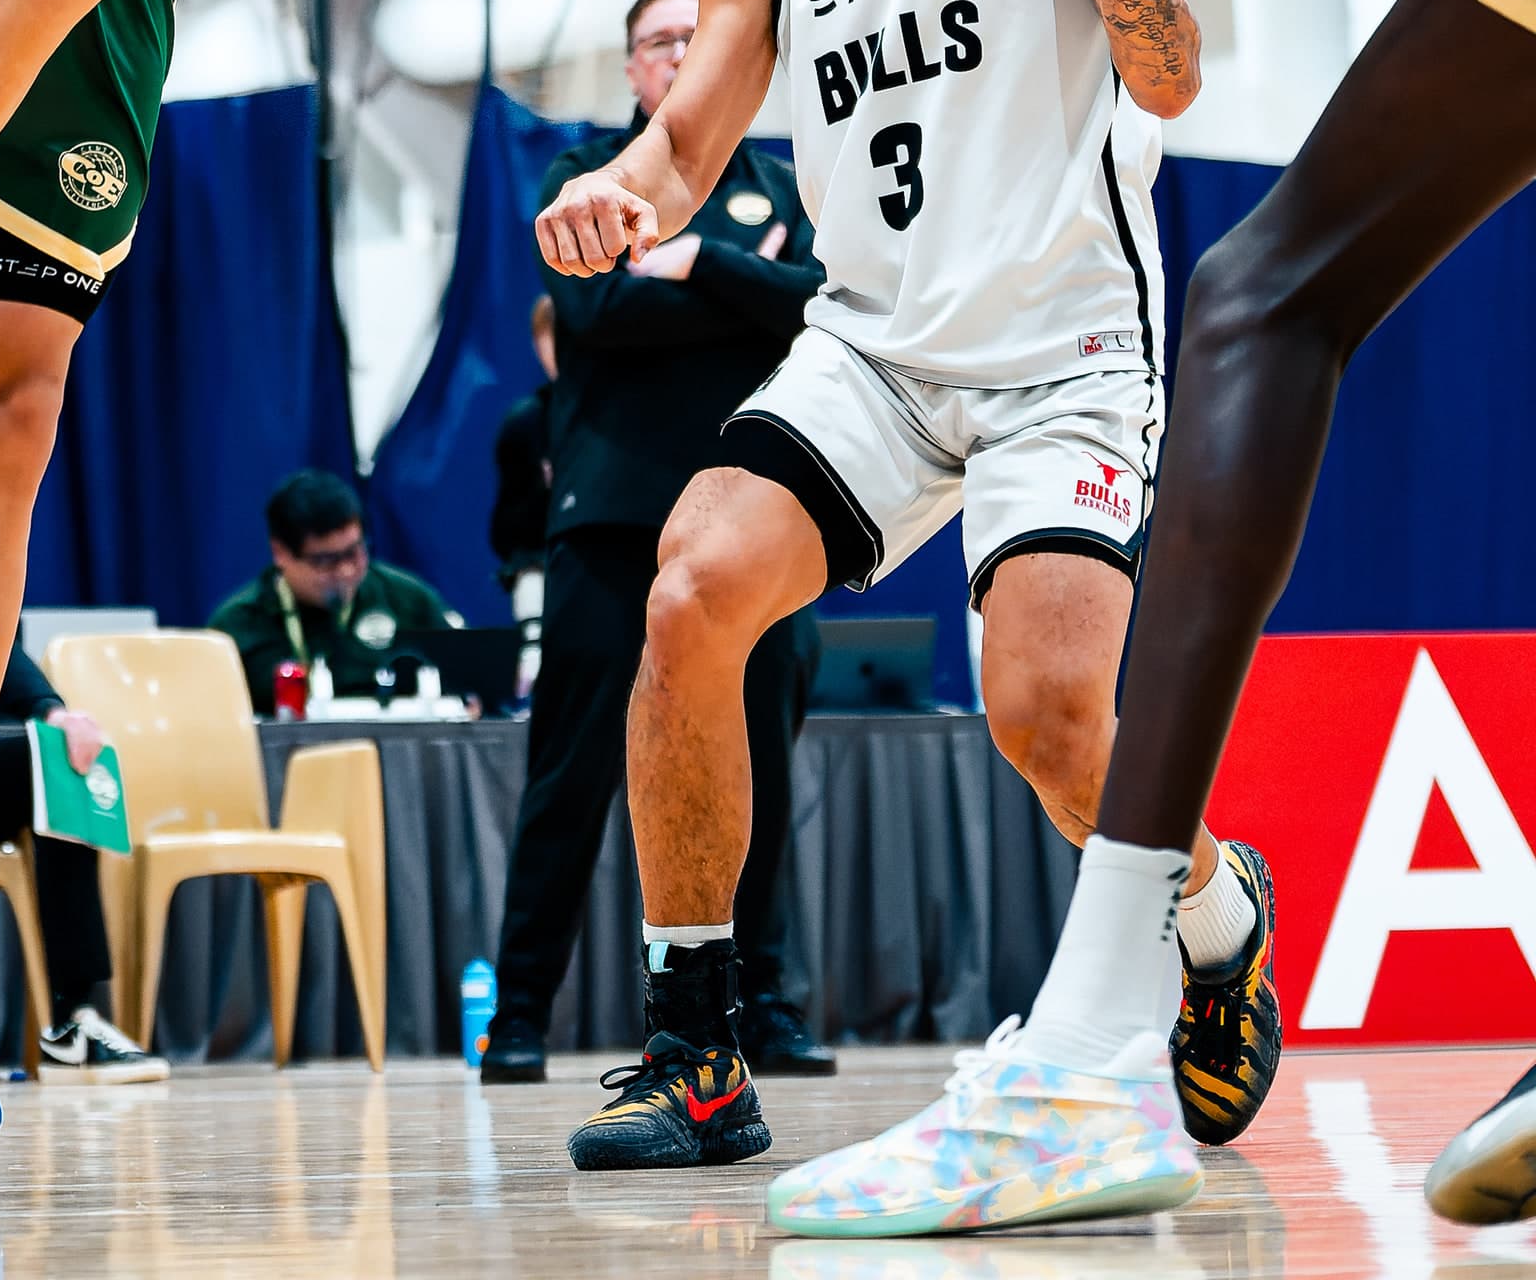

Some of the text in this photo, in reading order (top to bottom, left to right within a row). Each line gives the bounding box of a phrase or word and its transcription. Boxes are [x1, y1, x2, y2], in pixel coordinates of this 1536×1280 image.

[814, 0, 983, 126] BULLS
[869, 121, 925, 231] 3
[63, 271, 103, 295] ONE
[1074, 496, 1131, 528] BASKETBALL
[1075, 479, 1131, 517] BULLS
